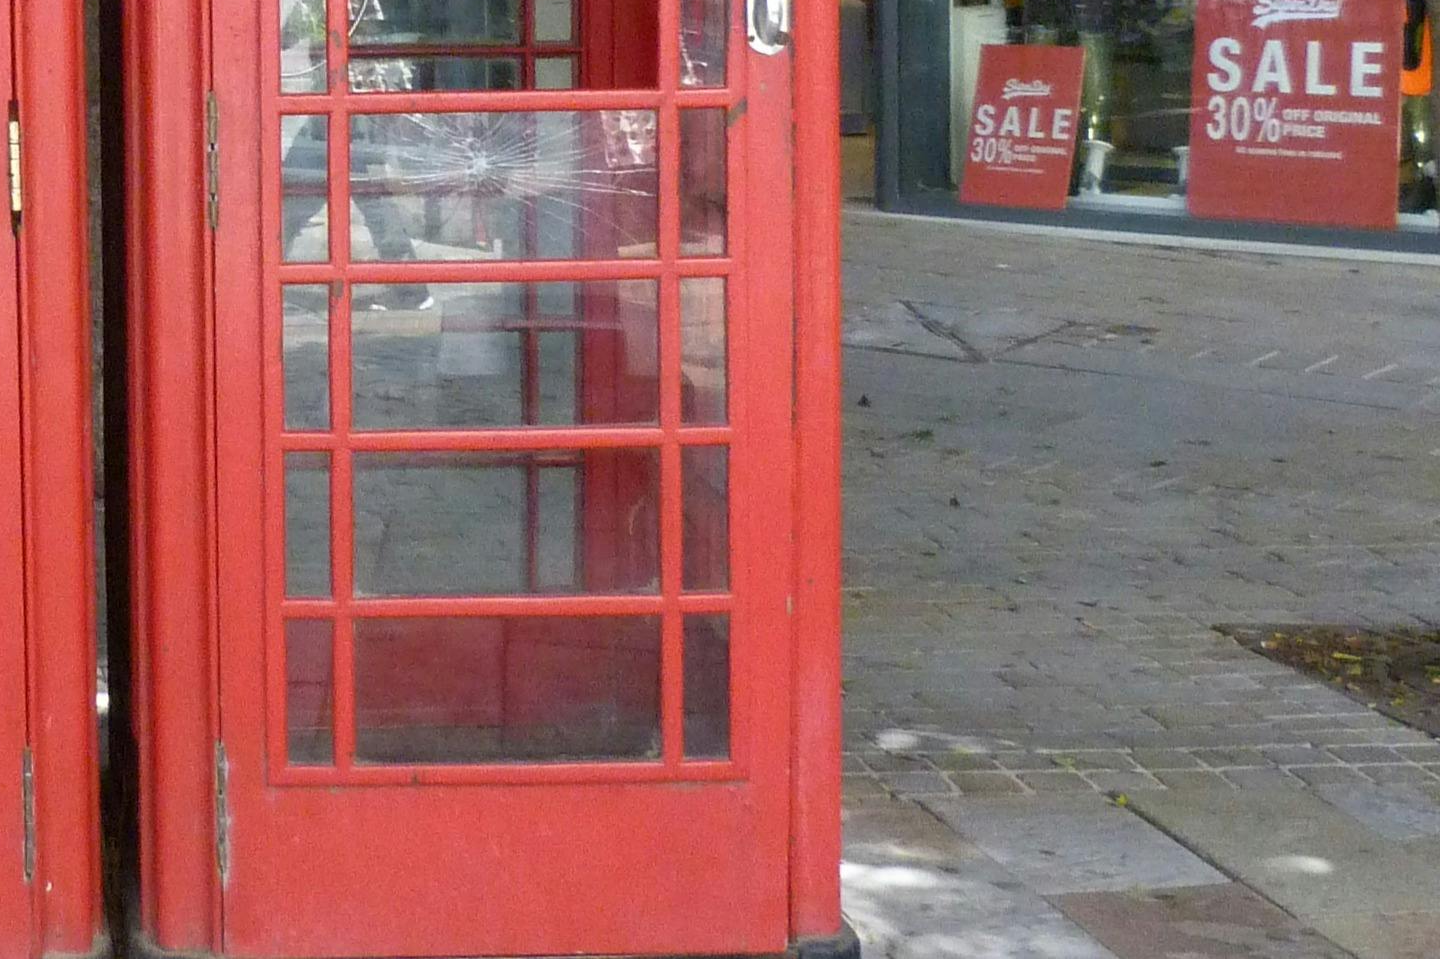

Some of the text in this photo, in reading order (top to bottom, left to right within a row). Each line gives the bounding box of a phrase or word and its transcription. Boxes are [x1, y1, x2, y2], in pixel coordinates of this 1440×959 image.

[1207, 37, 1384, 98] SALE
[974, 104, 1073, 140] SALE
[1206, 95, 1382, 143] 30% OFF ORIGINAL
[1282, 124, 1326, 139] PRICE
[970, 137, 1013, 164] 30%
